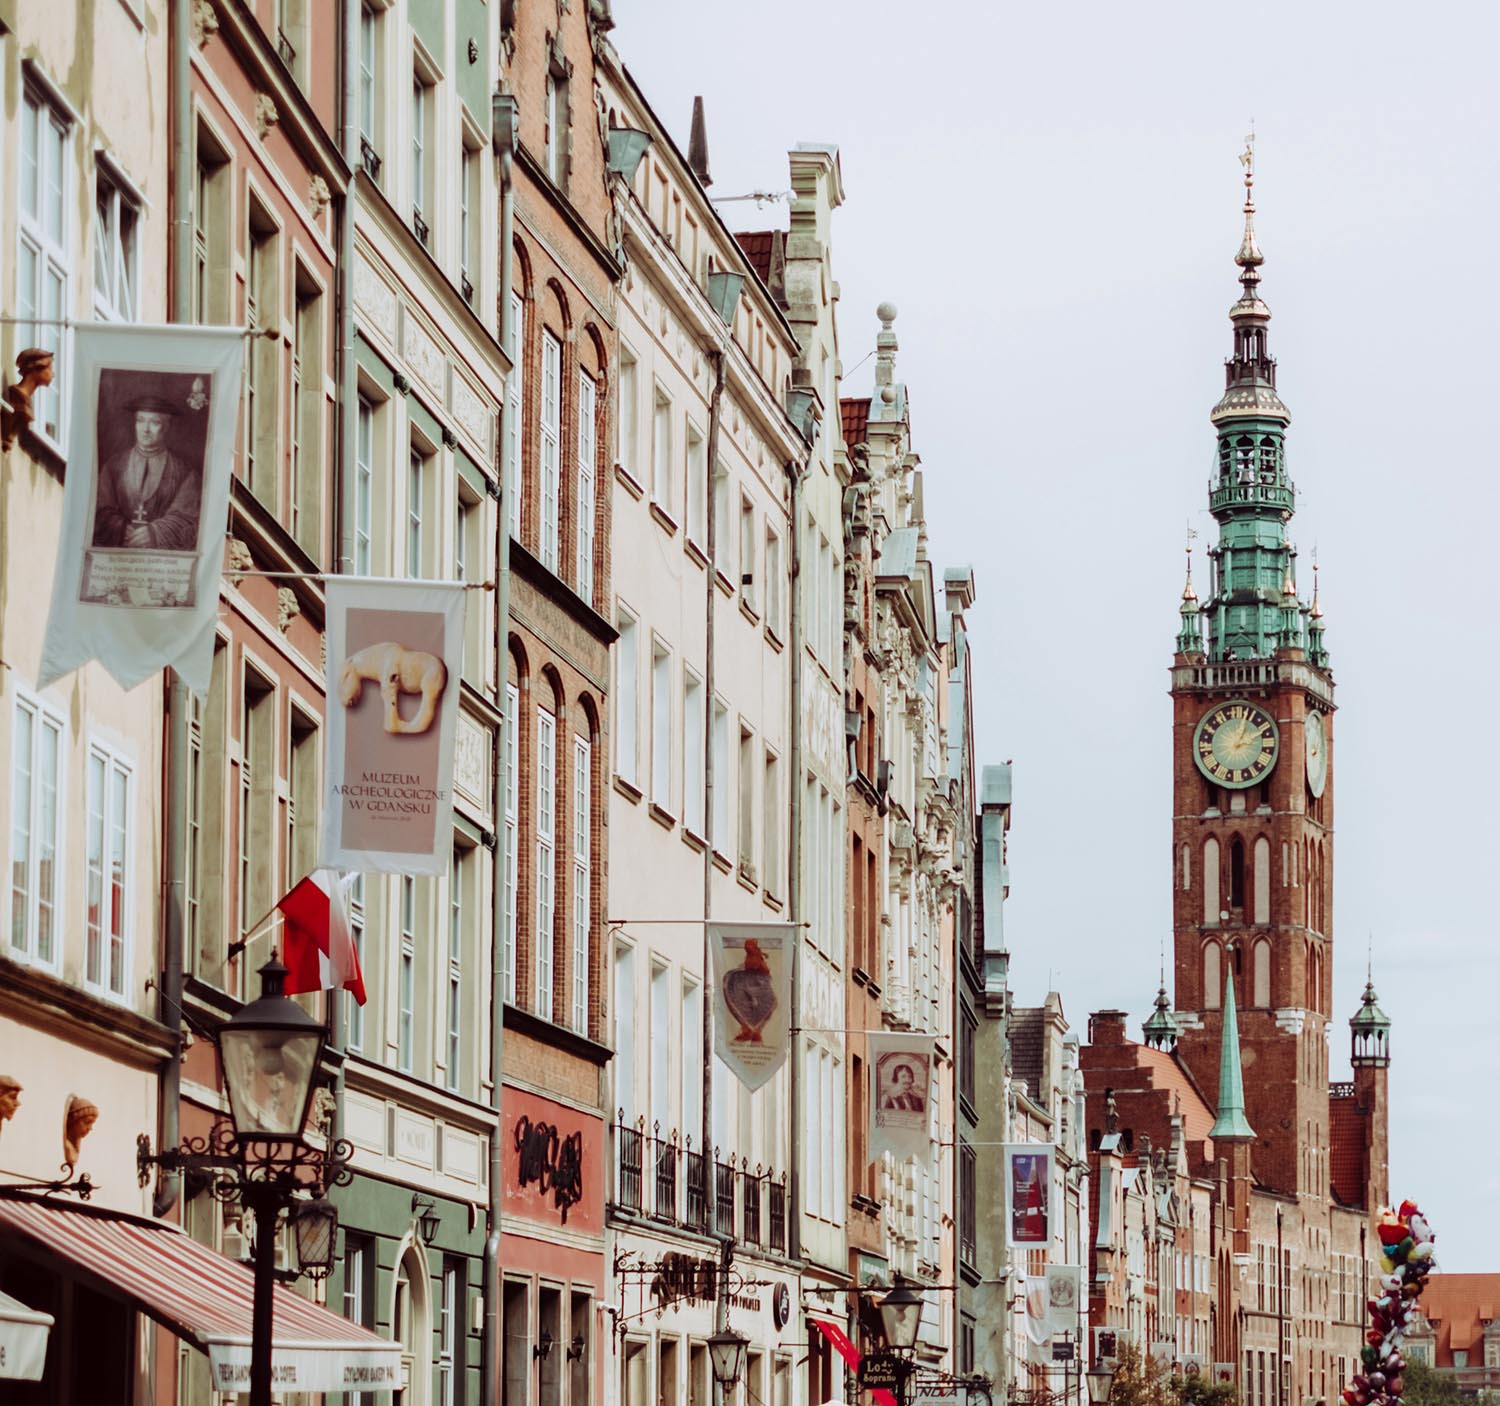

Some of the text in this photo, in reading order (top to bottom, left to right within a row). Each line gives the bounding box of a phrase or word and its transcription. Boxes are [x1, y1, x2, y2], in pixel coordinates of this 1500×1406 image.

[361, 772, 420, 785] MUZEUM
[331, 784, 447, 800] ARCHEOLOGICZNE
[349, 799, 363, 810] W
[863, 1373, 896, 1384] Soprano
[919, 1387, 958, 1398] NOVA
